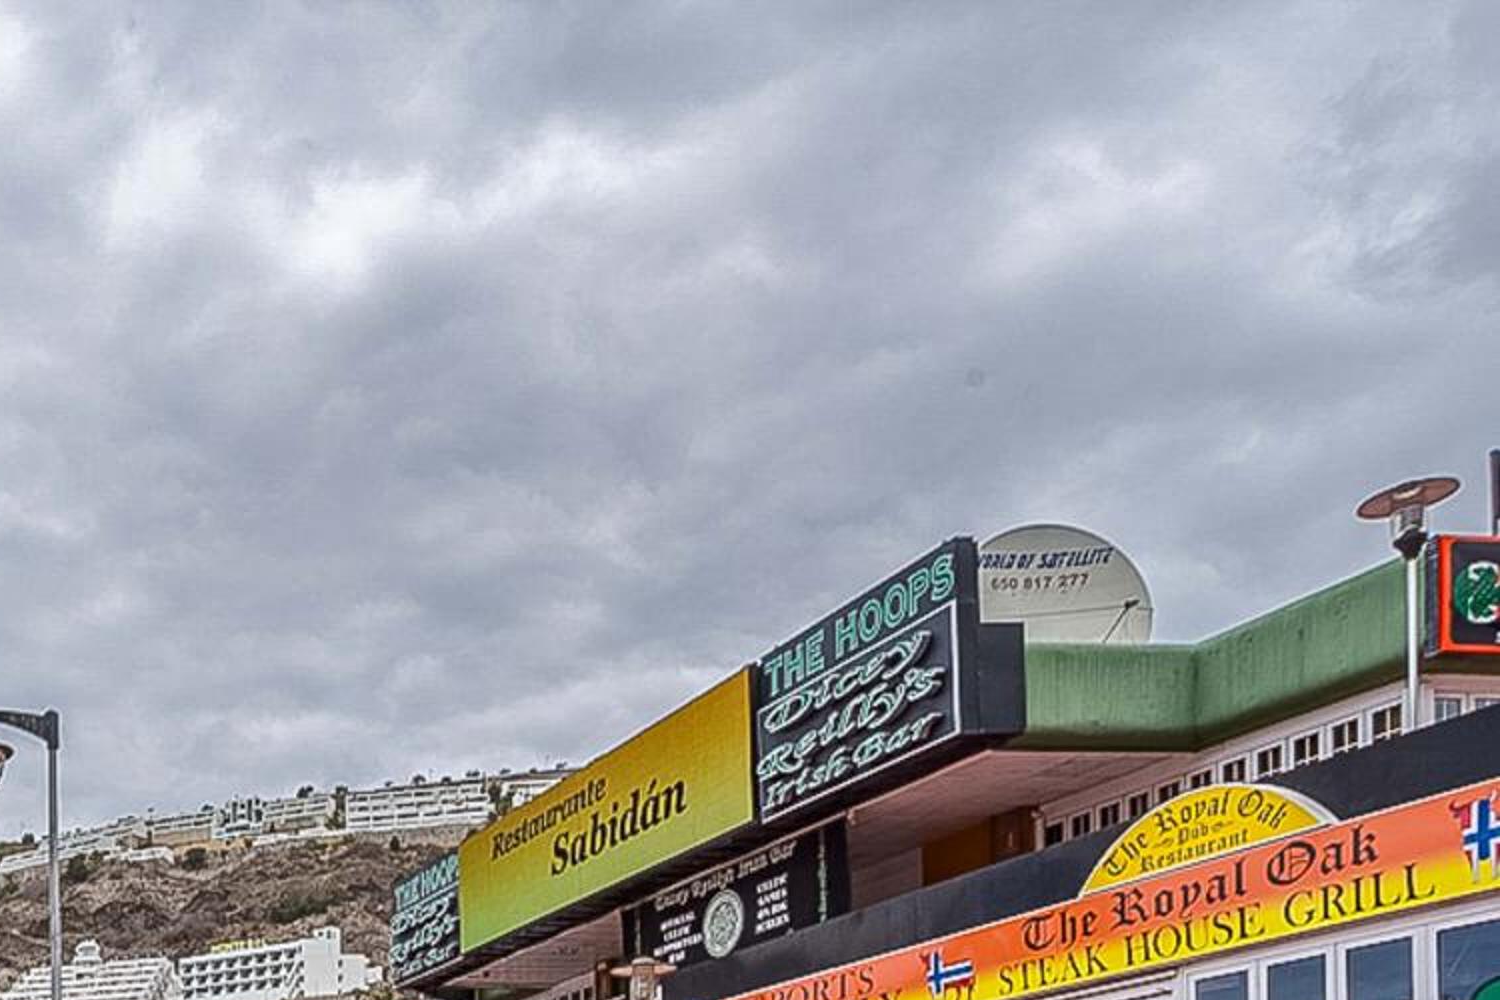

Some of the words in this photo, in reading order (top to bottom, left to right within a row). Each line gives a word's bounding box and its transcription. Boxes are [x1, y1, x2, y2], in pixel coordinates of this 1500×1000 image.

[764, 628, 825, 697] THE
[834, 553, 955, 658] HOOPS
[852, 712, 943, 768] Bar
[490, 777, 607, 861] Restaurante
[550, 778, 687, 876] Sabidán
[1103, 832, 1148, 876] The
[1154, 790, 1230, 832] Royal
[1237, 789, 1288, 829] Oak
[1140, 829, 1249, 873] Restaurant
[1178, 822, 1209, 844] Pub
[998, 942, 1110, 996] STEAK
[1124, 902, 1266, 967] HOUSE
[1282, 861, 1436, 927] GRILL
[1021, 909, 1099, 952] The
[1111, 860, 1247, 928] Royal
[1266, 825, 1380, 885] Oak
